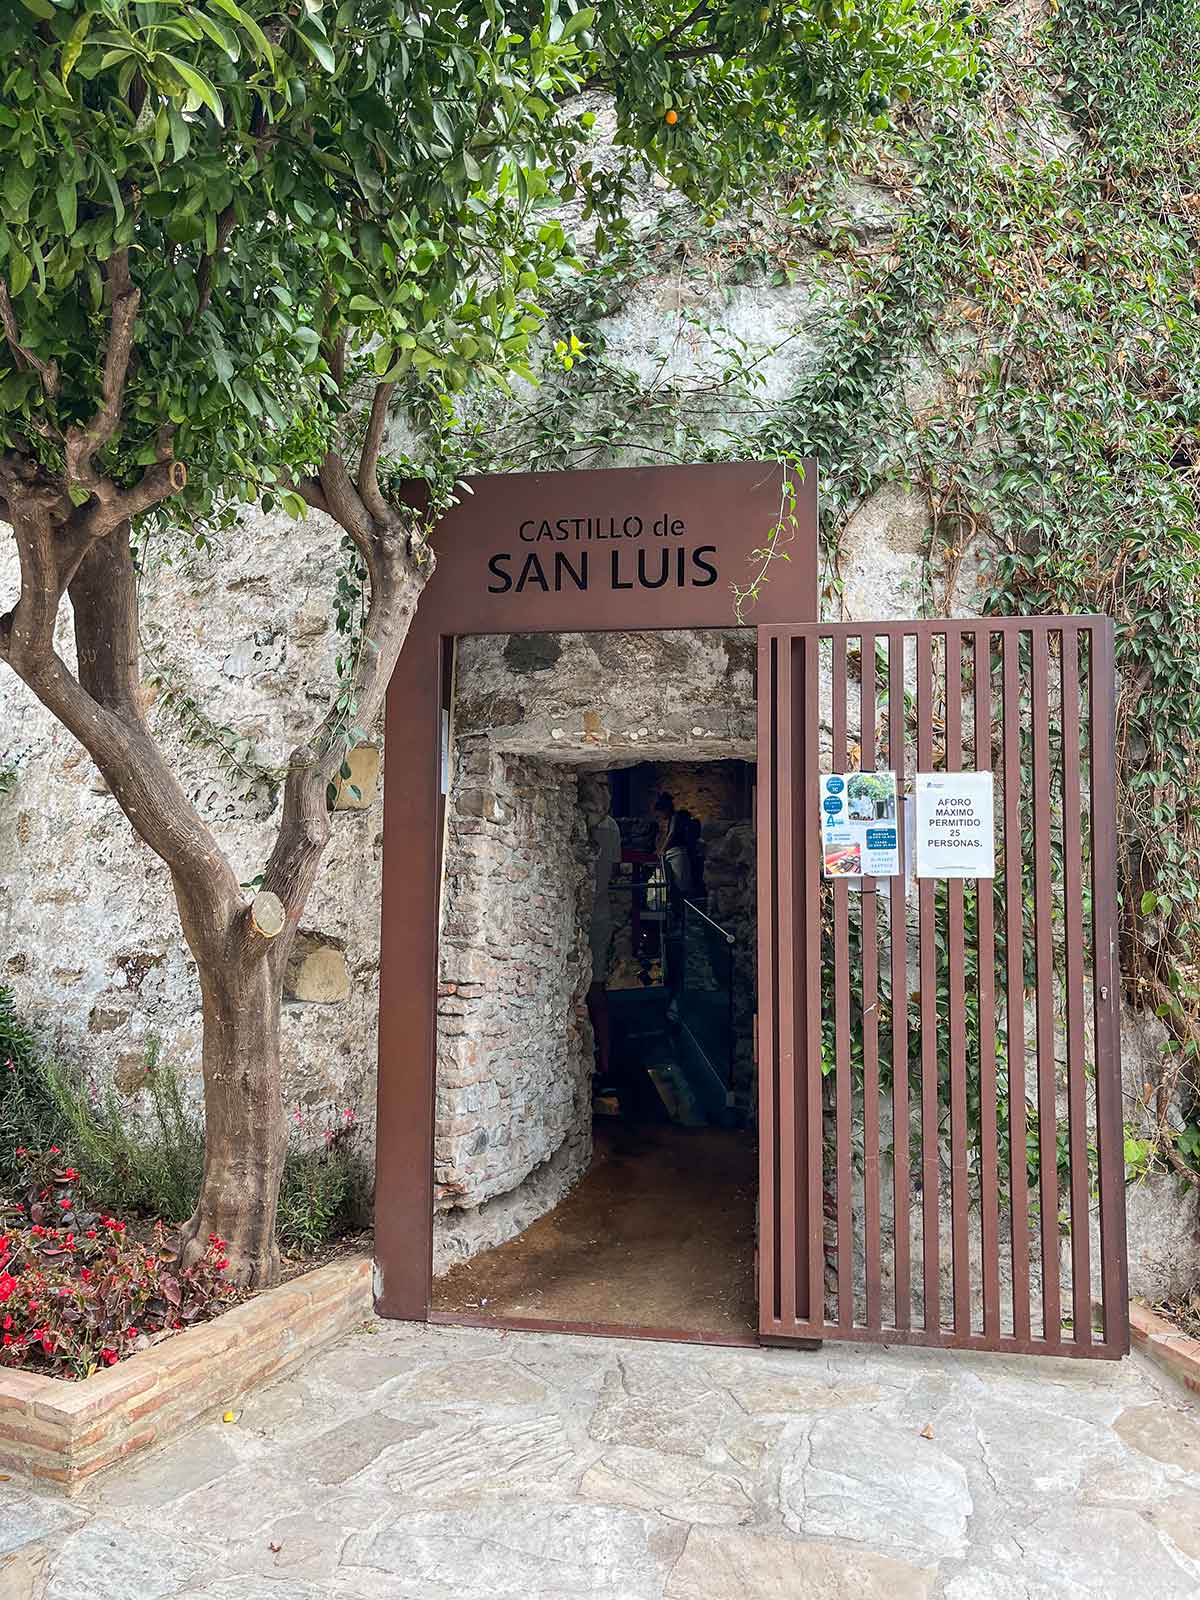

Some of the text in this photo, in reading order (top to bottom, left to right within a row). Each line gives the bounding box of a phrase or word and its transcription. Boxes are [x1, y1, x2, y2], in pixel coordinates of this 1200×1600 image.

[519, 513, 685, 541] CASTILLO de
[487, 545, 718, 593] SAN LUIS
[937, 798, 972, 806] AFORO
[935, 806, 974, 816] MÁXIMO
[929, 818, 981, 827] PERMITIDO
[949, 829, 961, 837] 25
[928, 839, 983, 847] PERSONAS.
